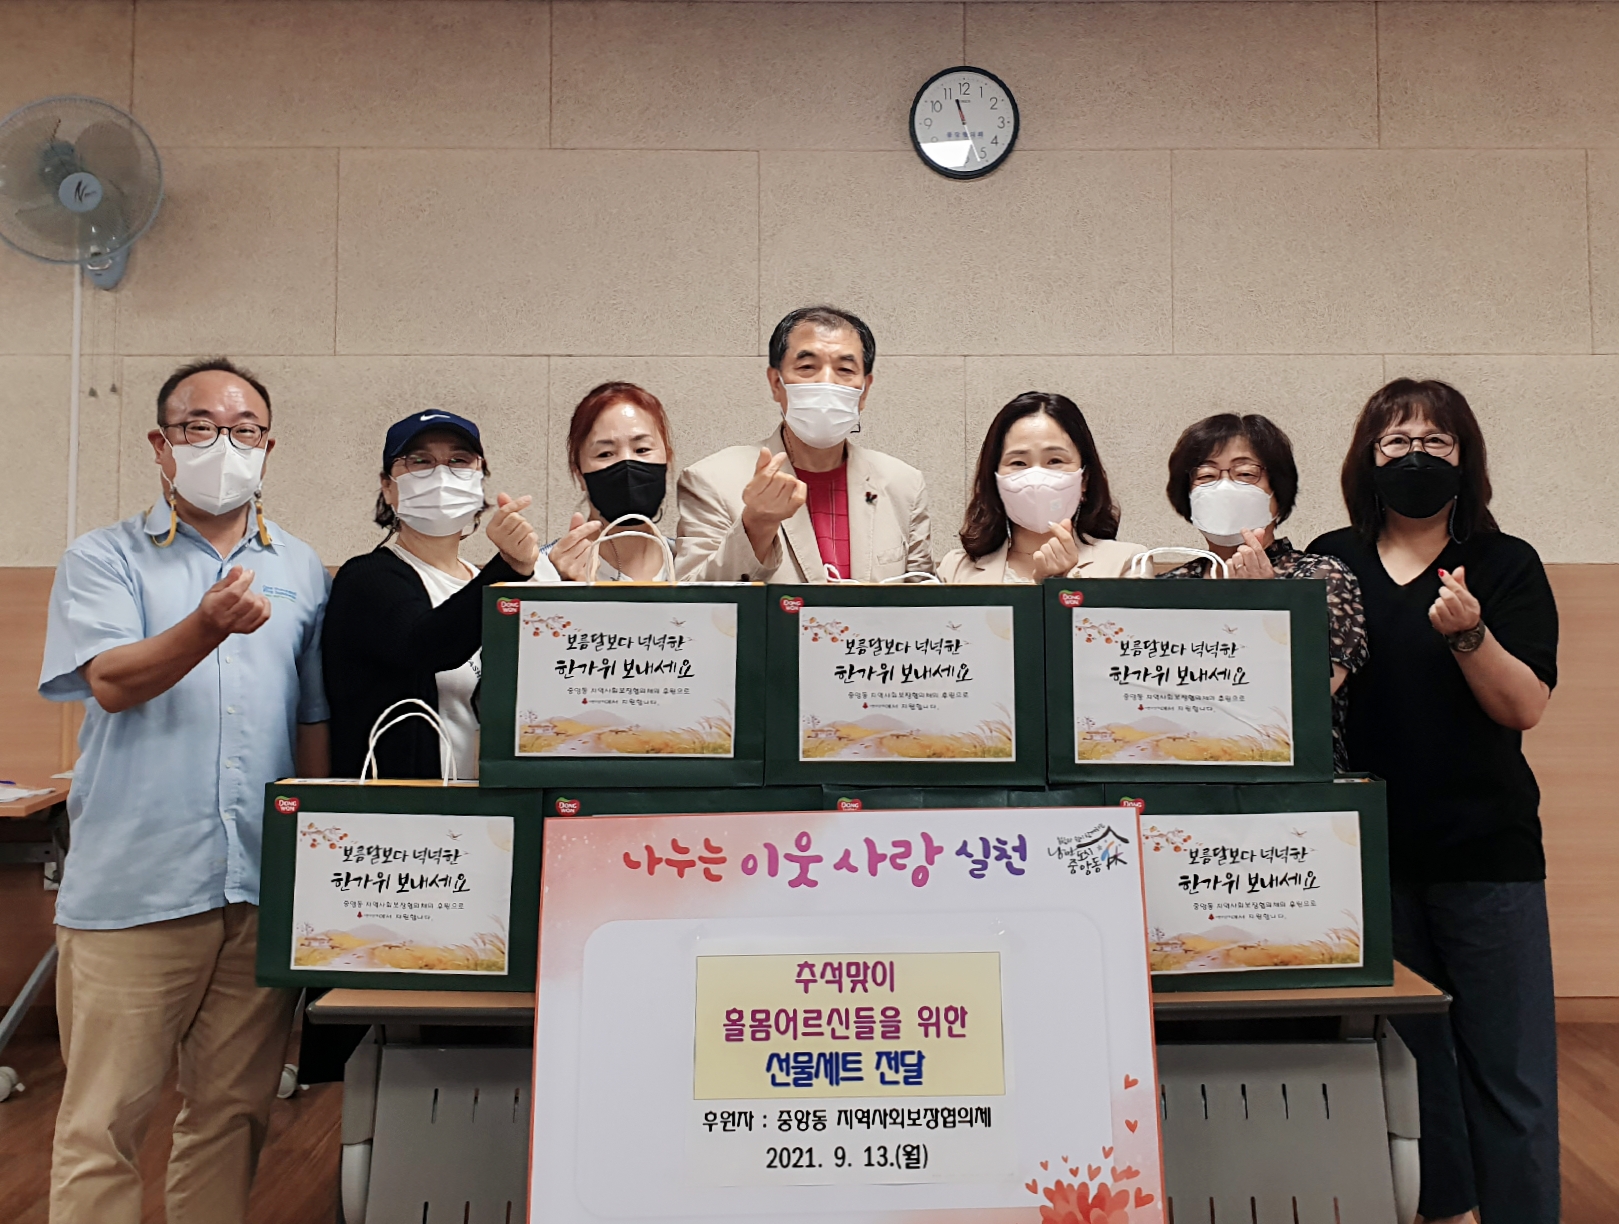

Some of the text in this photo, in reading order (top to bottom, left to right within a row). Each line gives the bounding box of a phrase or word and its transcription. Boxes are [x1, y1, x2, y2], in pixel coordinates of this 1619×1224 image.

[943, 87, 952, 100] 11
[958, 82, 970, 96] 12
[979, 86, 983, 98] 1
[930, 100, 942, 113] 10
[989, 97, 998, 110] 2
[923, 117, 933, 130] 9
[997, 116, 1005, 129] 3
[990, 135, 999, 146] 4
[979, 147, 987, 159] 5
[1062, 593, 1081, 601] DONG
[566, 634, 685, 652] 보름달보다 넉넉한
[844, 638, 962, 656] 보름달보다 넉넉한
[1120, 640, 1236, 659] 보름달보다 넉넉한
[554, 659, 696, 680] 한가위 보내세요
[834, 663, 973, 684] 한가위 보내세요
[1109, 665, 1250, 687] 한가위 보내세요
[342, 845, 459, 865] 보름달보다 넉넉한
[622, 837, 728, 883] 나누는
[740, 830, 823, 889] 이웃
[833, 831, 944, 888] 사랑
[955, 833, 1029, 877] 실천
[1076, 847, 1094, 861] 도시
[1188, 847, 1307, 866] 보름달보다 넉넉한
[1067, 856, 1102, 876] 중앙동
[330, 873, 471, 894] 한가위 보내세요
[1178, 870, 1321, 895] 한가위 보내세요
[795, 960, 895, 994] 추석맞이
[723, 1004, 968, 1042] 홀몸어르신들을 위한
[765, 1049, 926, 1088] 선물세트 전달
[702, 1111, 754, 1132] 후원자
[777, 1109, 827, 1132] 중앙동
[836, 1106, 992, 1130] 지역사회보장협의체
[766, 1144, 929, 1169] 2021. 9. 13.(월)
